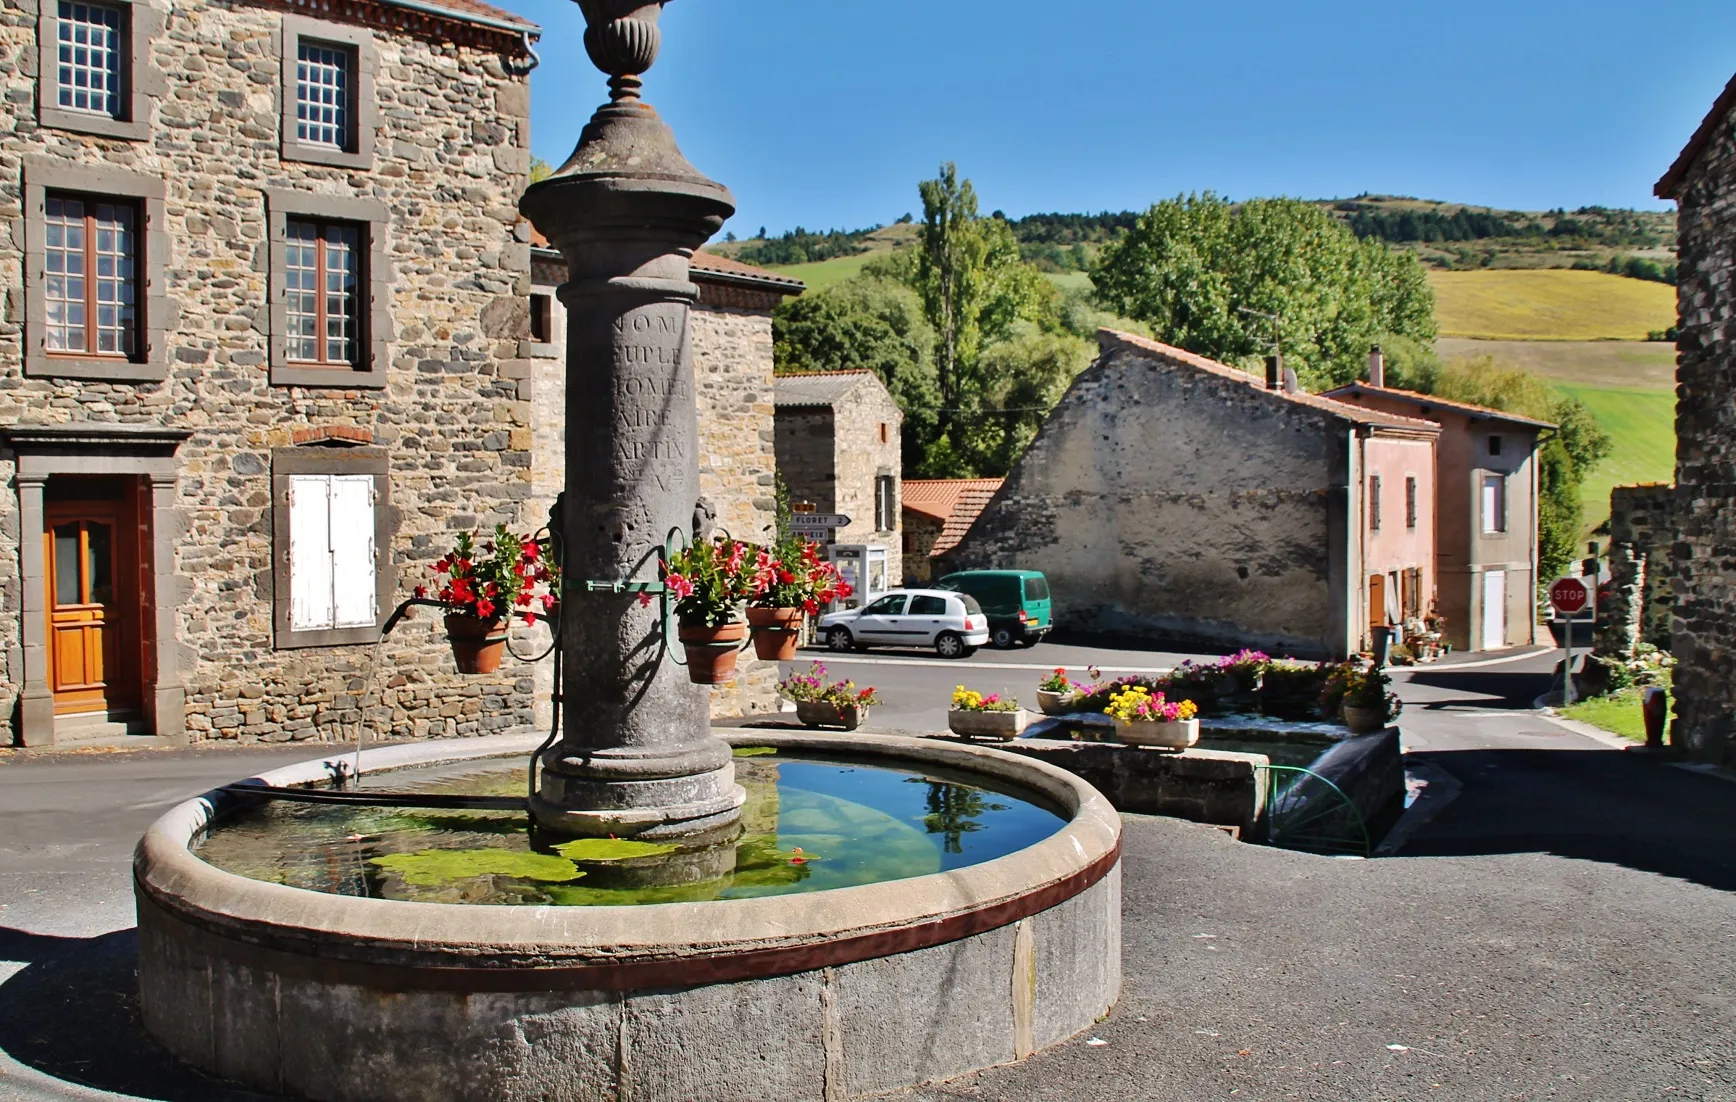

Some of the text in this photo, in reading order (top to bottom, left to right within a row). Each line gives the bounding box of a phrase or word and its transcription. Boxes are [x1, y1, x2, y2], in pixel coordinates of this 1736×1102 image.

[614, 409, 672, 428] AIRE
[613, 441, 685, 460] ARTIN
[1555, 590, 1584, 600] STOP
